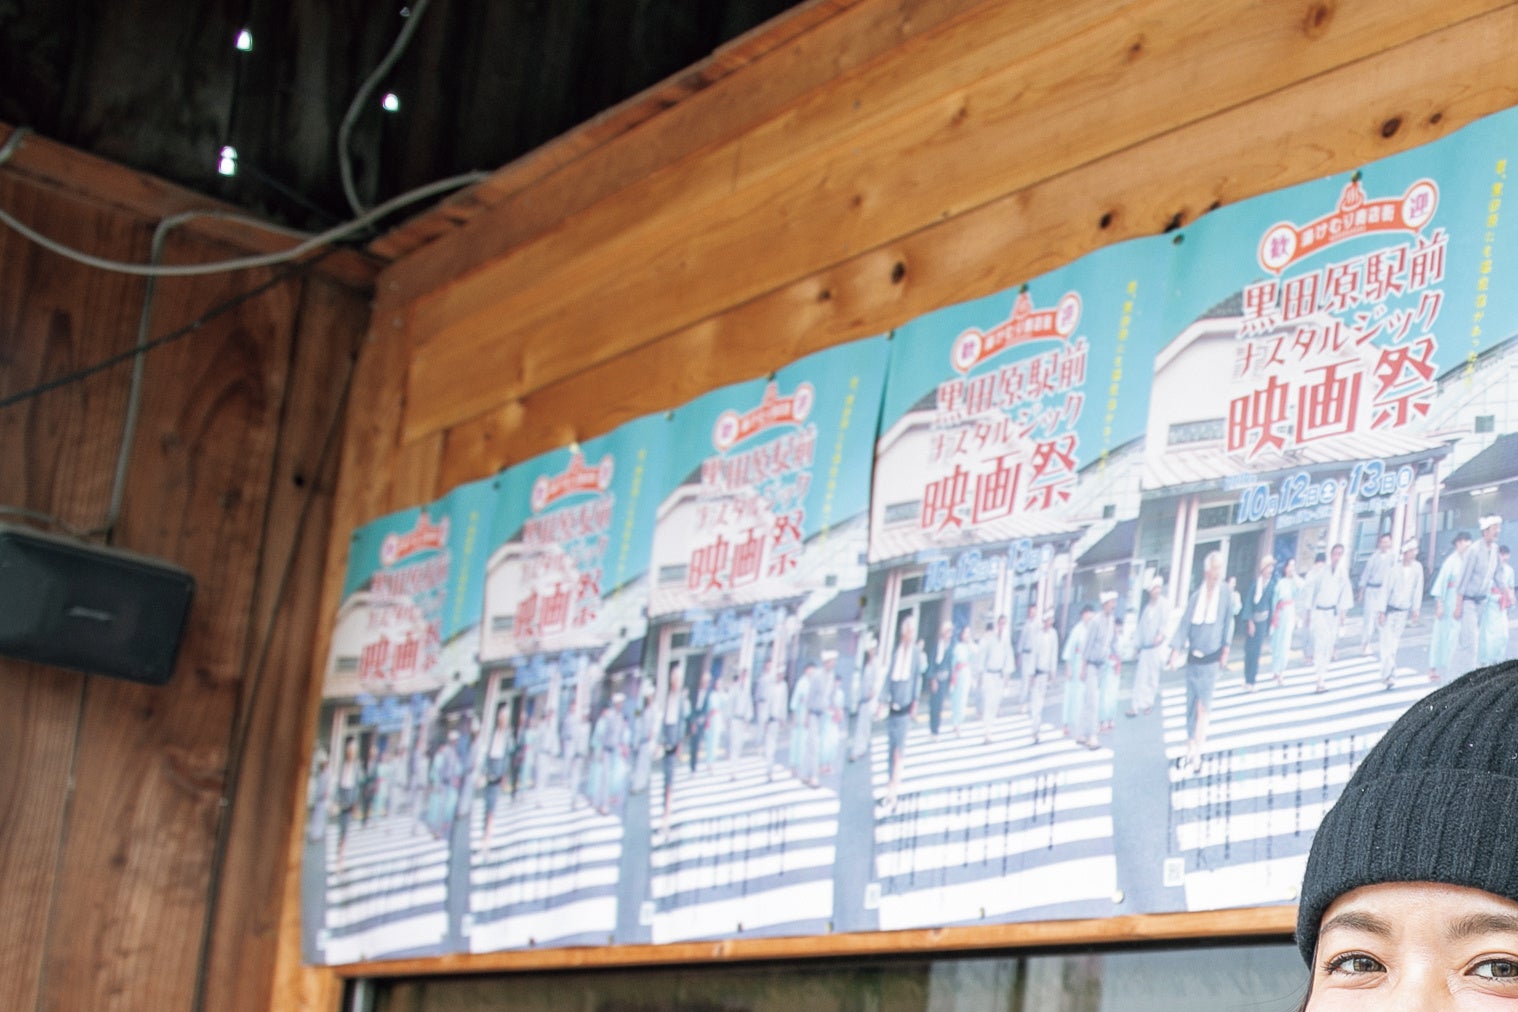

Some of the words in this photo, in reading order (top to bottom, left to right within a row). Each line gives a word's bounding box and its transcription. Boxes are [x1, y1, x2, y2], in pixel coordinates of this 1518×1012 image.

[1239, 229, 1448, 338] 黒田原駅前
[932, 336, 1088, 428] 黒田原駅前
[1237, 293, 1444, 380] ナスタルジック
[1226, 336, 1437, 460] 映画祭
[920, 434, 1078, 535] 映画祭
[688, 509, 805, 597] 映画祭
